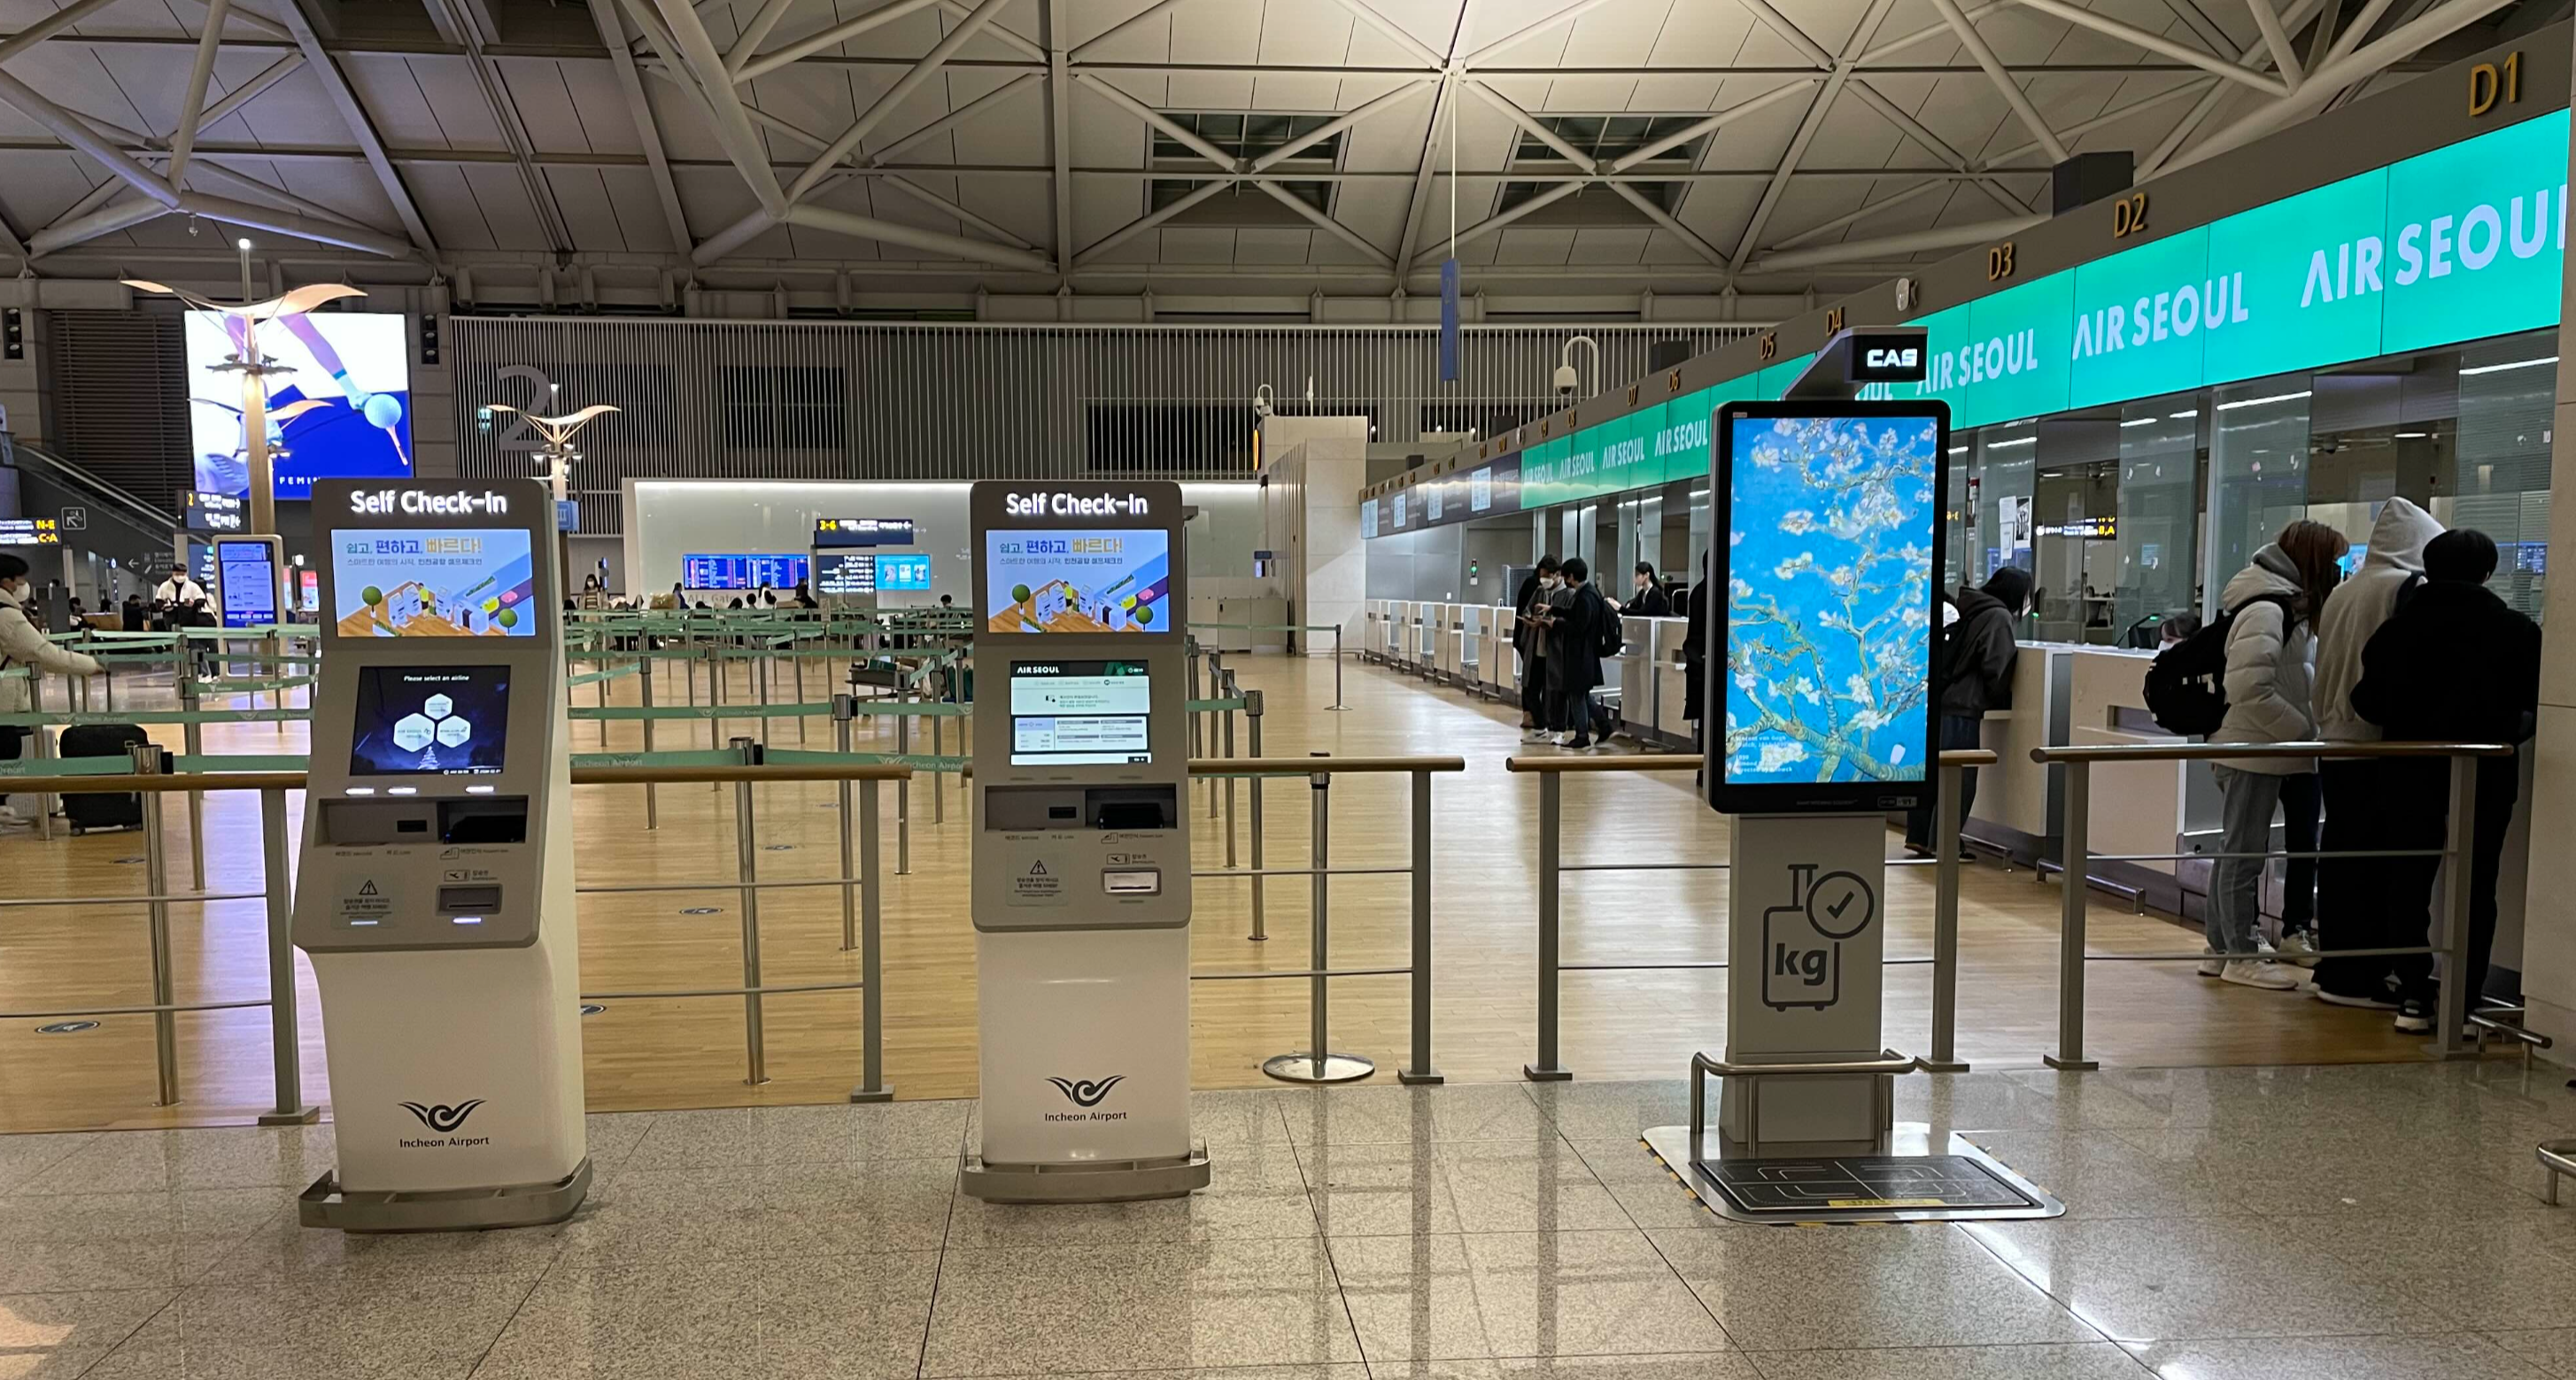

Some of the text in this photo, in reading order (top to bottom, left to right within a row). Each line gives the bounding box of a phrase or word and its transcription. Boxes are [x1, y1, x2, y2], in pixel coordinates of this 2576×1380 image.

[2468, 51, 2521, 118] D1
[2114, 192, 2148, 238] D2
[1988, 242, 2015, 282] D3
[2301, 236, 2384, 308] AIR
[1826, 306, 1845, 337] D4
[2073, 271, 2248, 361] AIR SEOUL
[1760, 333, 1776, 360] D5
[1867, 348, 1918, 368] CAS
[1916, 328, 2038, 397] AIR SEOUL
[1668, 368, 1681, 392] D6
[498, 364, 552, 452] 2
[1628, 385, 1639, 407] D7
[1655, 419, 1708, 457] AIR SEOUL
[1559, 451, 1595, 478] AIR SEOUL
[1602, 436, 1645, 470] AIR SEOUL
[280, 476, 320, 485] FEMI
[351, 489, 507, 514] Self Check-In
[1006, 492, 1149, 515] Self Check-In
[376, 539, 423, 554] 편하고,
[426, 538, 482, 554] 빠르다!
[1026, 539, 1070, 554] 편하고,
[1072, 538, 1123, 554] 빠르다!
[1774, 942, 1829, 987] kg
[1045, 1111, 1127, 1122] Incheon Airport
[399, 1136, 490, 1149] Incheon Airport
